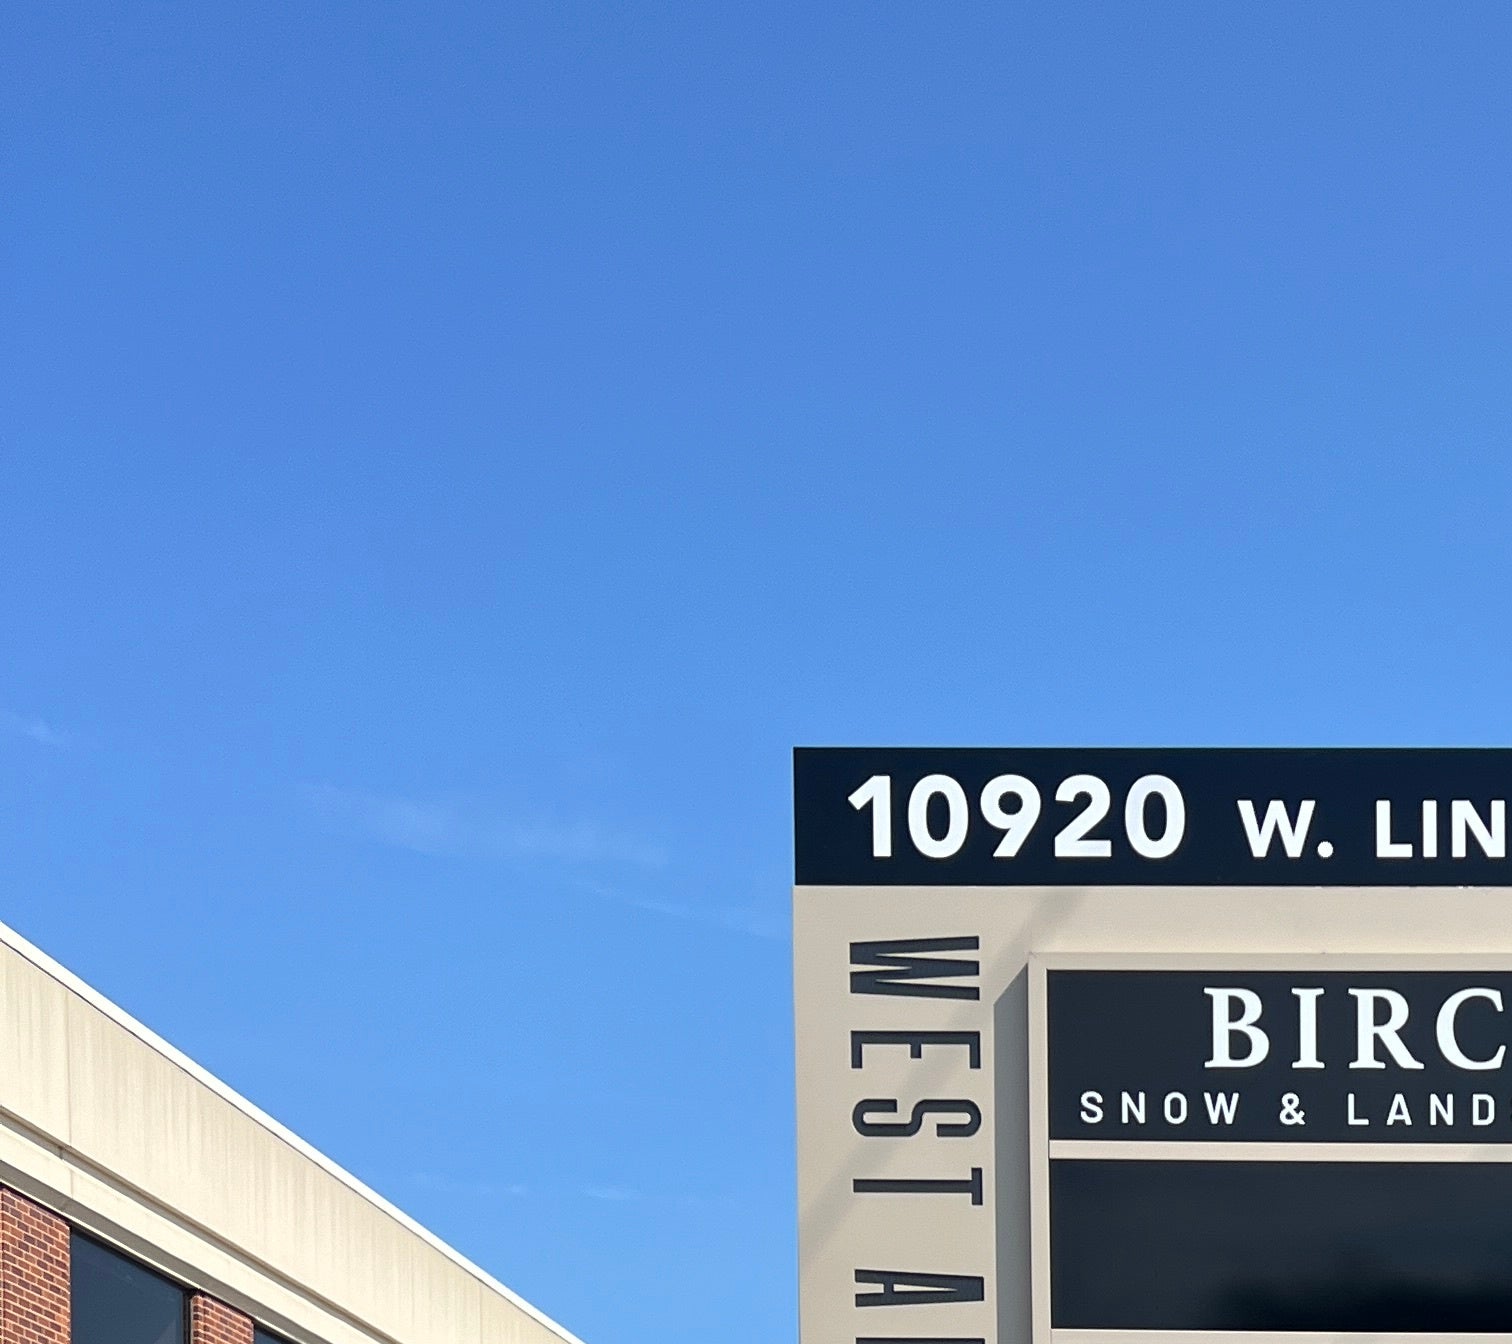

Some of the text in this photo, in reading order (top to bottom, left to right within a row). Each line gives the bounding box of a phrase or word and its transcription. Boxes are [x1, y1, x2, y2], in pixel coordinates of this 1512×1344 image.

[848, 775, 1185, 858] 10920
[1237, 799, 1333, 858] W.
[850, 936, 983, 1205] WEST
[1081, 1091, 1239, 1124] SNOW
[1280, 1093, 1305, 1125] &
